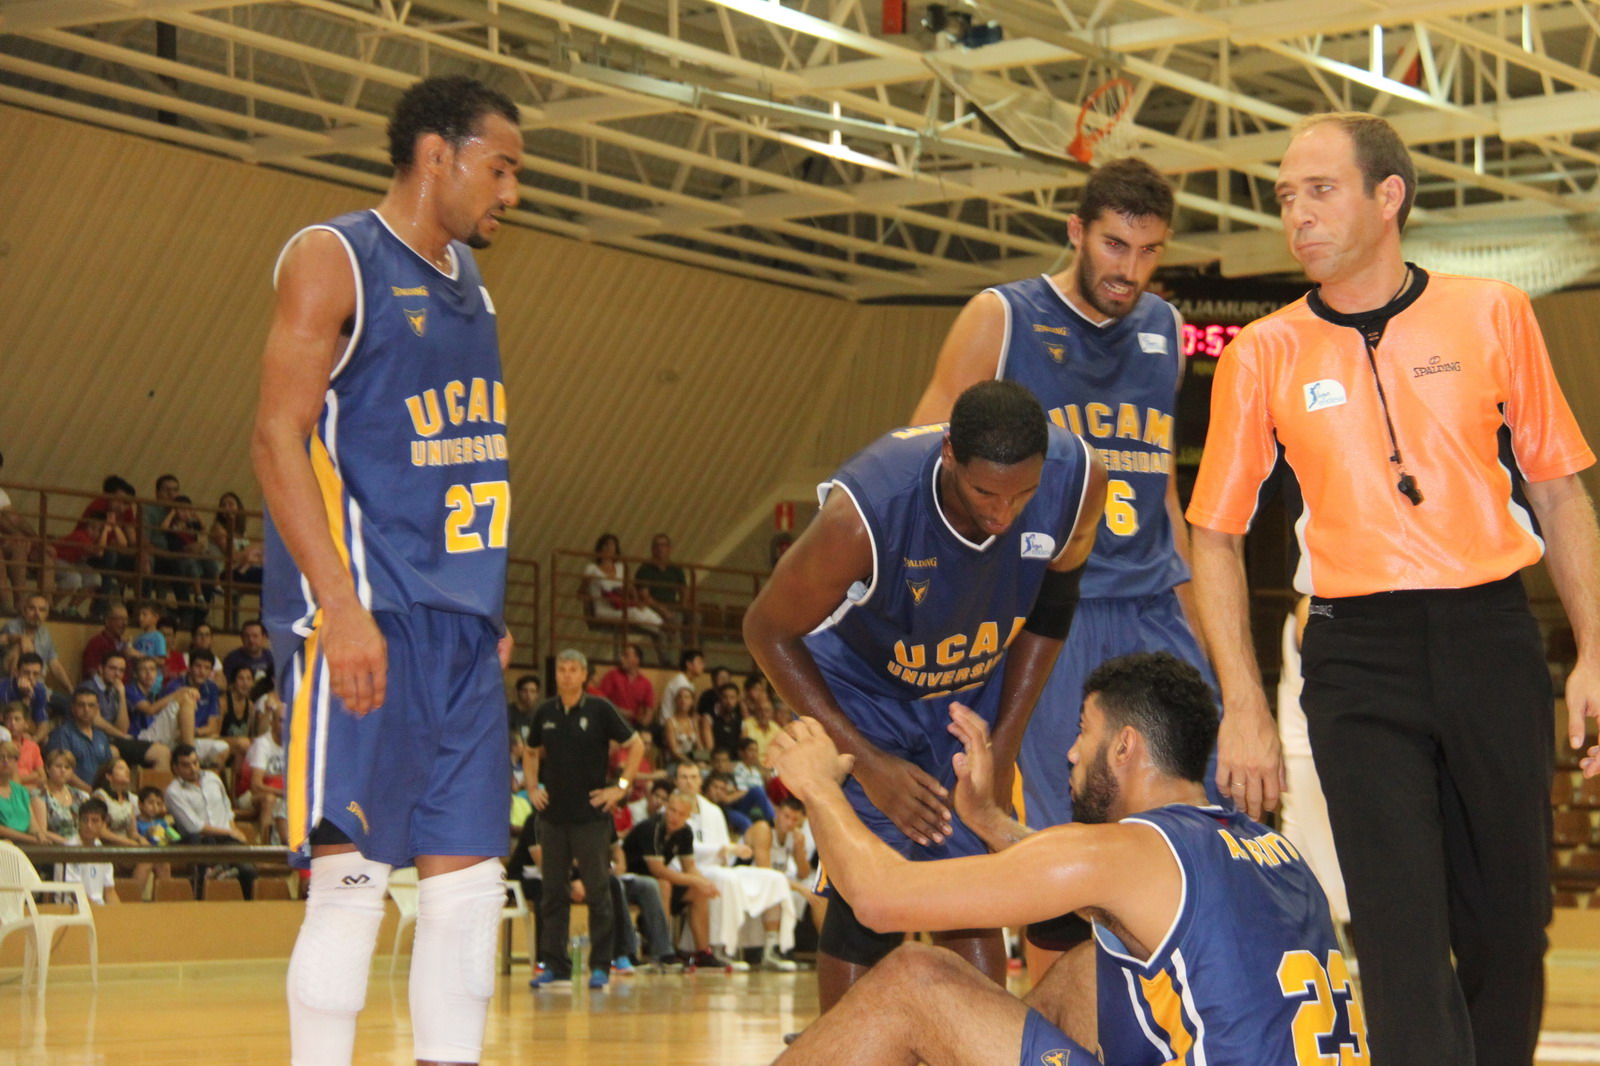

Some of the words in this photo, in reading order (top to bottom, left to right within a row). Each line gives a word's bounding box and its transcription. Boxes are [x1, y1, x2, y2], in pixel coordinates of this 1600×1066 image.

[1413, 361, 1461, 378] SPALDING
[445, 480, 511, 553] 27
[1105, 479, 1140, 536] 6
[1276, 949, 1371, 1066] 23
